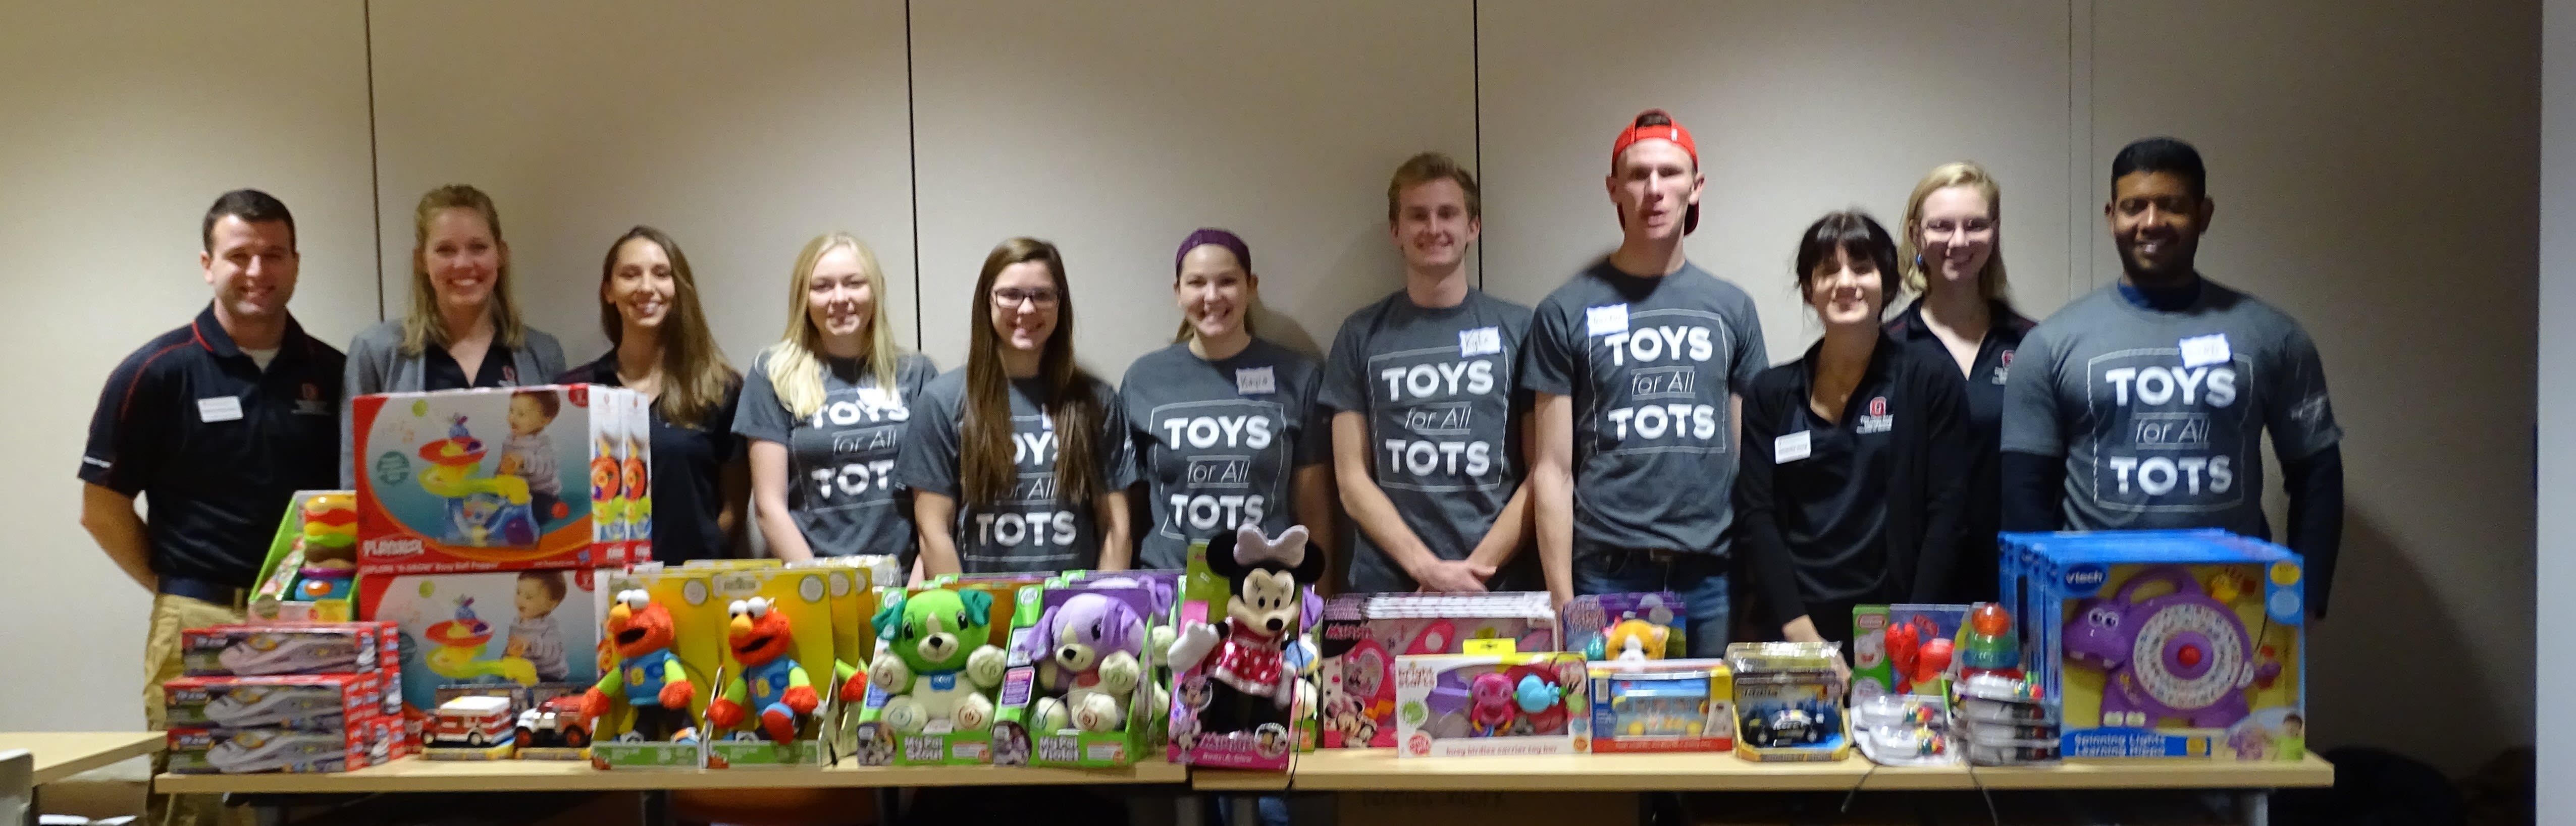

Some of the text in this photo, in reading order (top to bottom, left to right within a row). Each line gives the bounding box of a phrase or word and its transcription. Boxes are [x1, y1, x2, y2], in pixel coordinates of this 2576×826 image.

[1604, 325, 1713, 366] TOYS
[1381, 359, 1494, 402] TOYS
[1632, 371, 1695, 396] for All
[2106, 366, 2236, 407] TOYS
[1164, 415, 1272, 450] TOYS
[1405, 406, 1471, 430] for All
[1607, 403, 1716, 442] TOTS
[2135, 417, 2211, 444] for All
[868, 429, 897, 451] All
[1385, 438, 1490, 476] TOTS
[811, 459, 895, 499] TOT
[1027, 477, 1057, 500] All
[1187, 459, 1250, 483] for All
[2110, 455, 2233, 495] TOTS
[976, 510, 1077, 546] TOTS
[1170, 493, 1265, 531] TOTS
